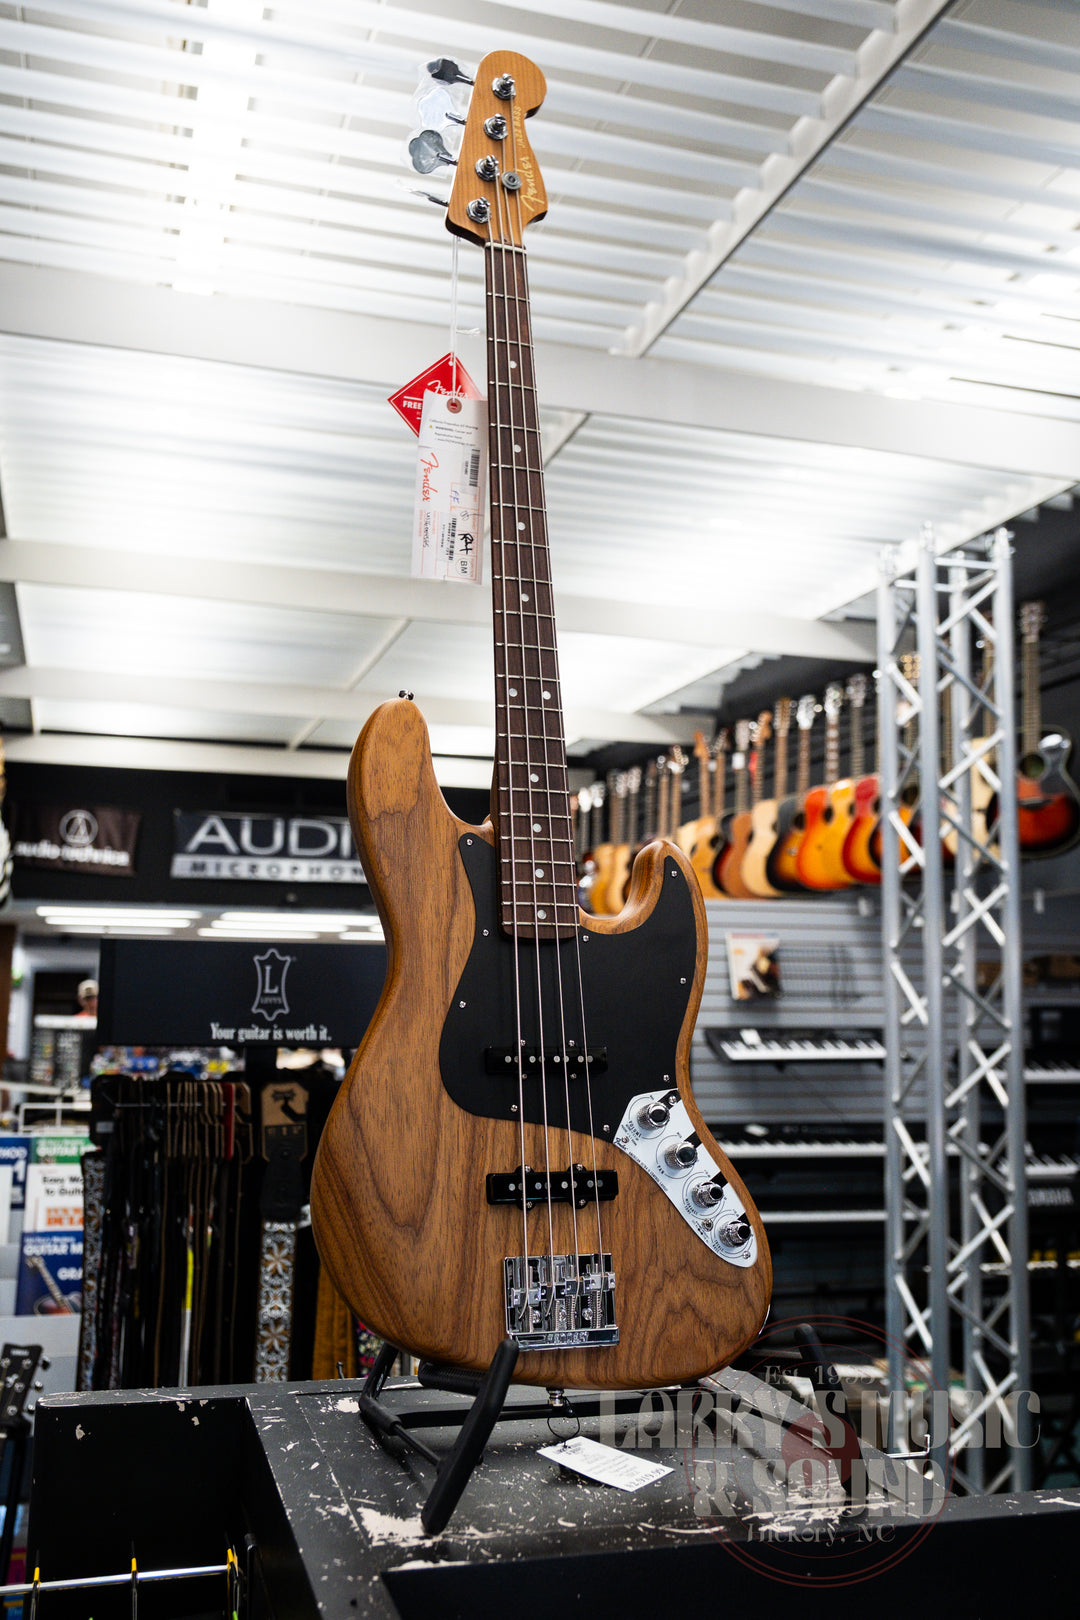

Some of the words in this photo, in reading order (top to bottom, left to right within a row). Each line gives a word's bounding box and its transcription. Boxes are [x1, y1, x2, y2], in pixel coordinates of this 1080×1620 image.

[515, 156, 545, 212] Fender
[420, 452, 439, 502] Fender
[185, 815, 351, 858] AUDI
[190, 862, 366, 877] MICROPHON
[263, 965, 279, 994] L
[210, 1022, 236, 1040] Your
[237, 1023, 271, 1042] guitar
[273, 1024, 283, 1040] is
[285, 1024, 317, 1041] worth
[319, 1024, 332, 1041] it.
